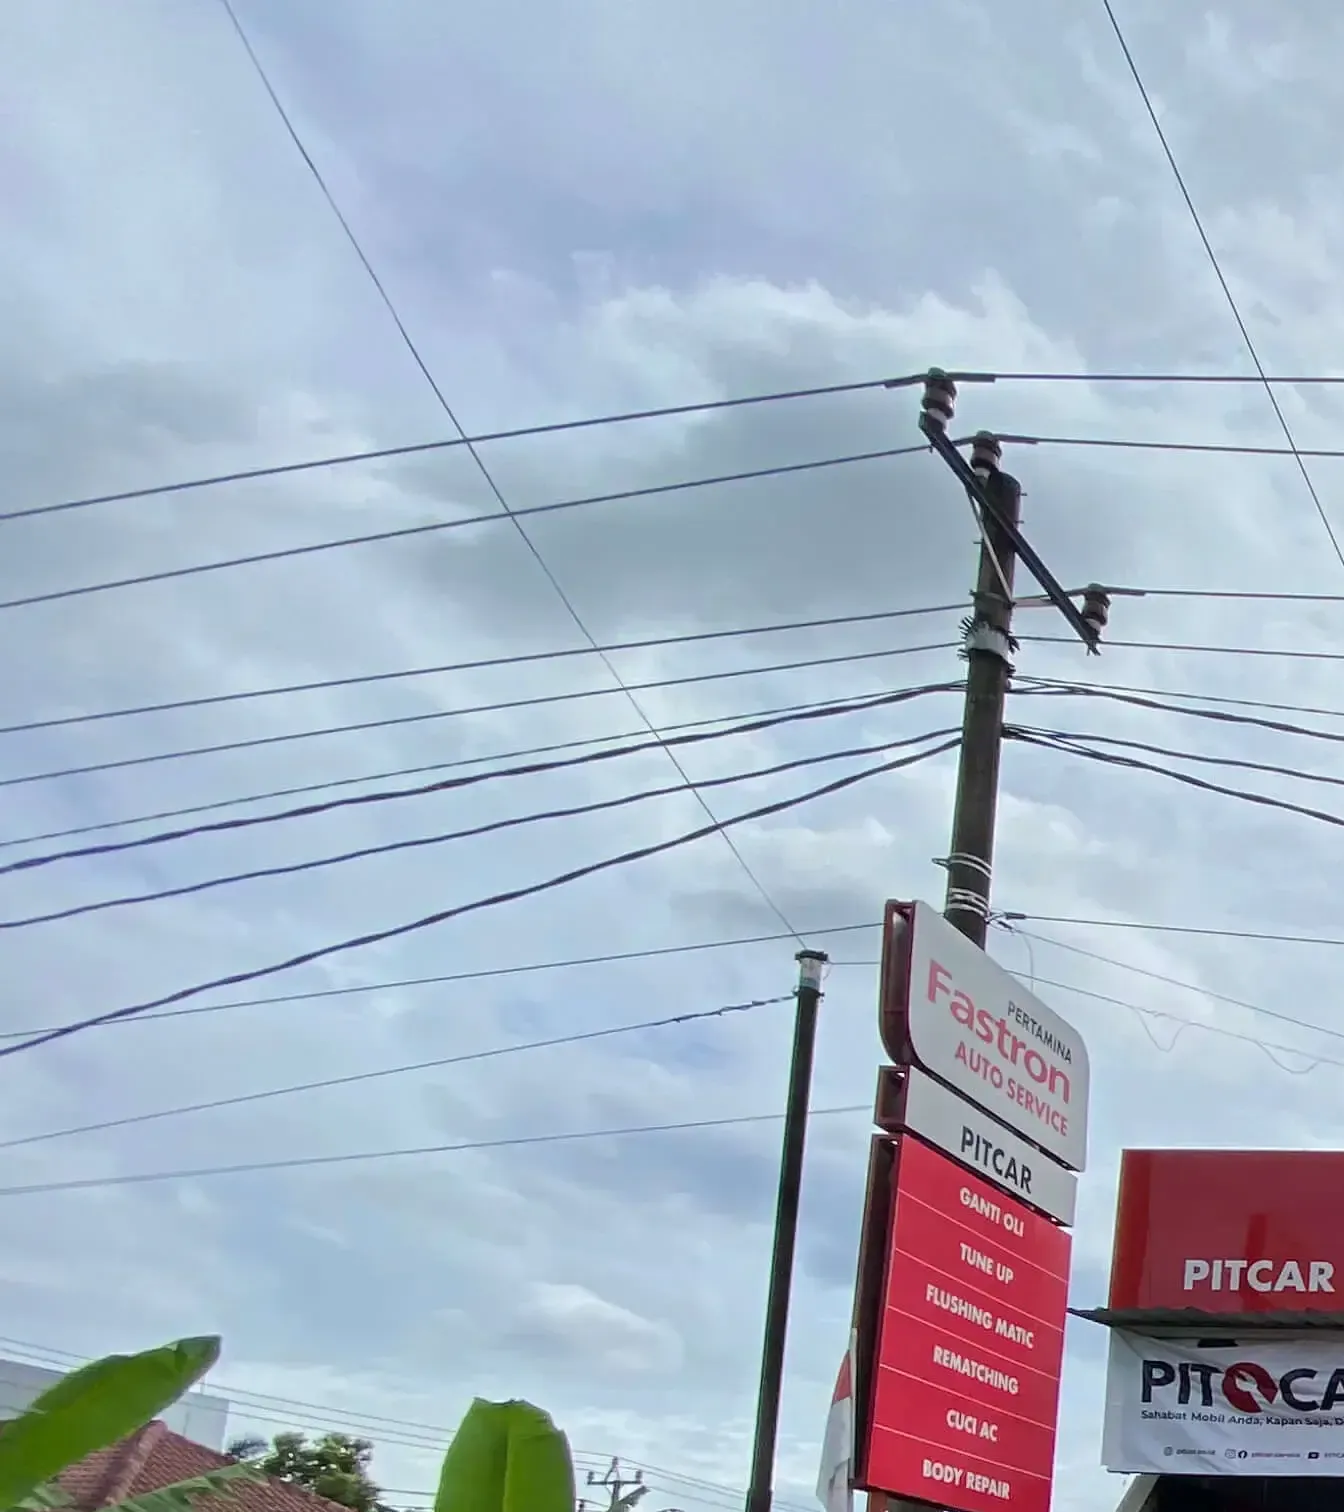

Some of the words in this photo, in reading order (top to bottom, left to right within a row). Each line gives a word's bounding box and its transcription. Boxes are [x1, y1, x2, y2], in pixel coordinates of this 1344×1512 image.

[927, 959, 1071, 1104] Fastron
[1007, 1001, 1072, 1065] PERTAMINA
[954, 1040, 1004, 1089] AUTO
[1007, 1080, 1068, 1137] SERVICE
[961, 1125, 1032, 1195] PITCAR
[959, 1187, 1001, 1224] GANTI
[1003, 1213, 1024, 1237] OLI
[959, 1242, 994, 1276] TUNE
[996, 1262, 1014, 1284] UP
[1183, 1259, 1336, 1293] PITCAR
[926, 1283, 992, 1330] FLUSHING
[995, 1318, 1035, 1349] MATIC
[932, 1345, 1019, 1395] REMATCHING
[946, 1409, 977, 1435] CUCI
[980, 1422, 999, 1442] AC
[1141, 1410, 1188, 1421] Sahabat
[1191, 1412, 1225, 1424] Mobil
[1266, 1416, 1302, 1427] Kapan
[922, 1459, 964, 1486] BODY
[965, 1471, 1010, 1500] REPAIR
